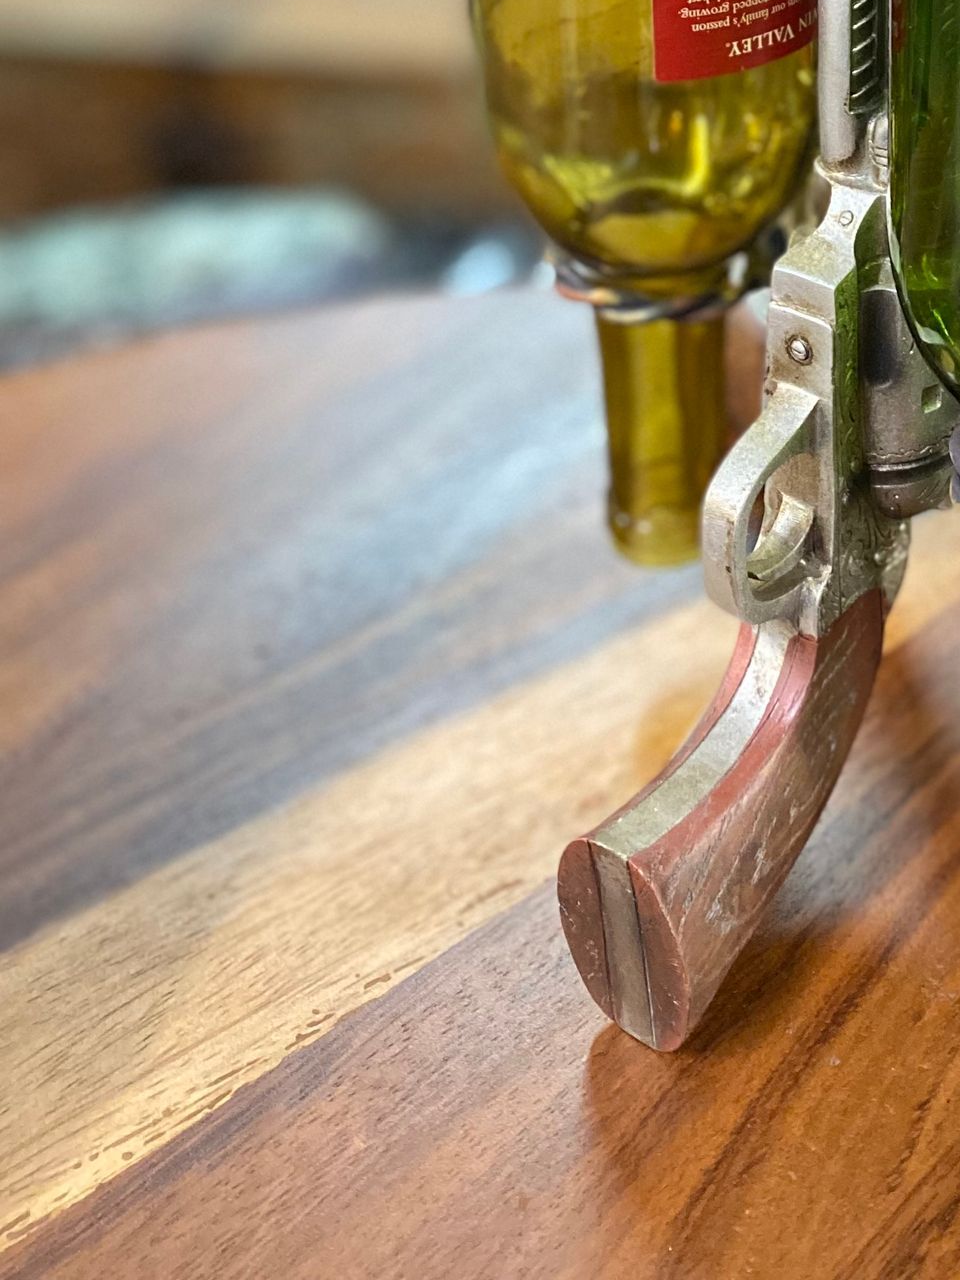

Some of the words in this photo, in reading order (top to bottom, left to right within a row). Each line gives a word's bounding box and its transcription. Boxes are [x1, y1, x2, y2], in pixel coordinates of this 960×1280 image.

[678, 2, 729, 20] growing.
[771, 2, 786, 14] our
[691, 16, 730, 34] passion
[733, 8, 769, 28] family's
[725, 24, 795, 57] VALLEY.
